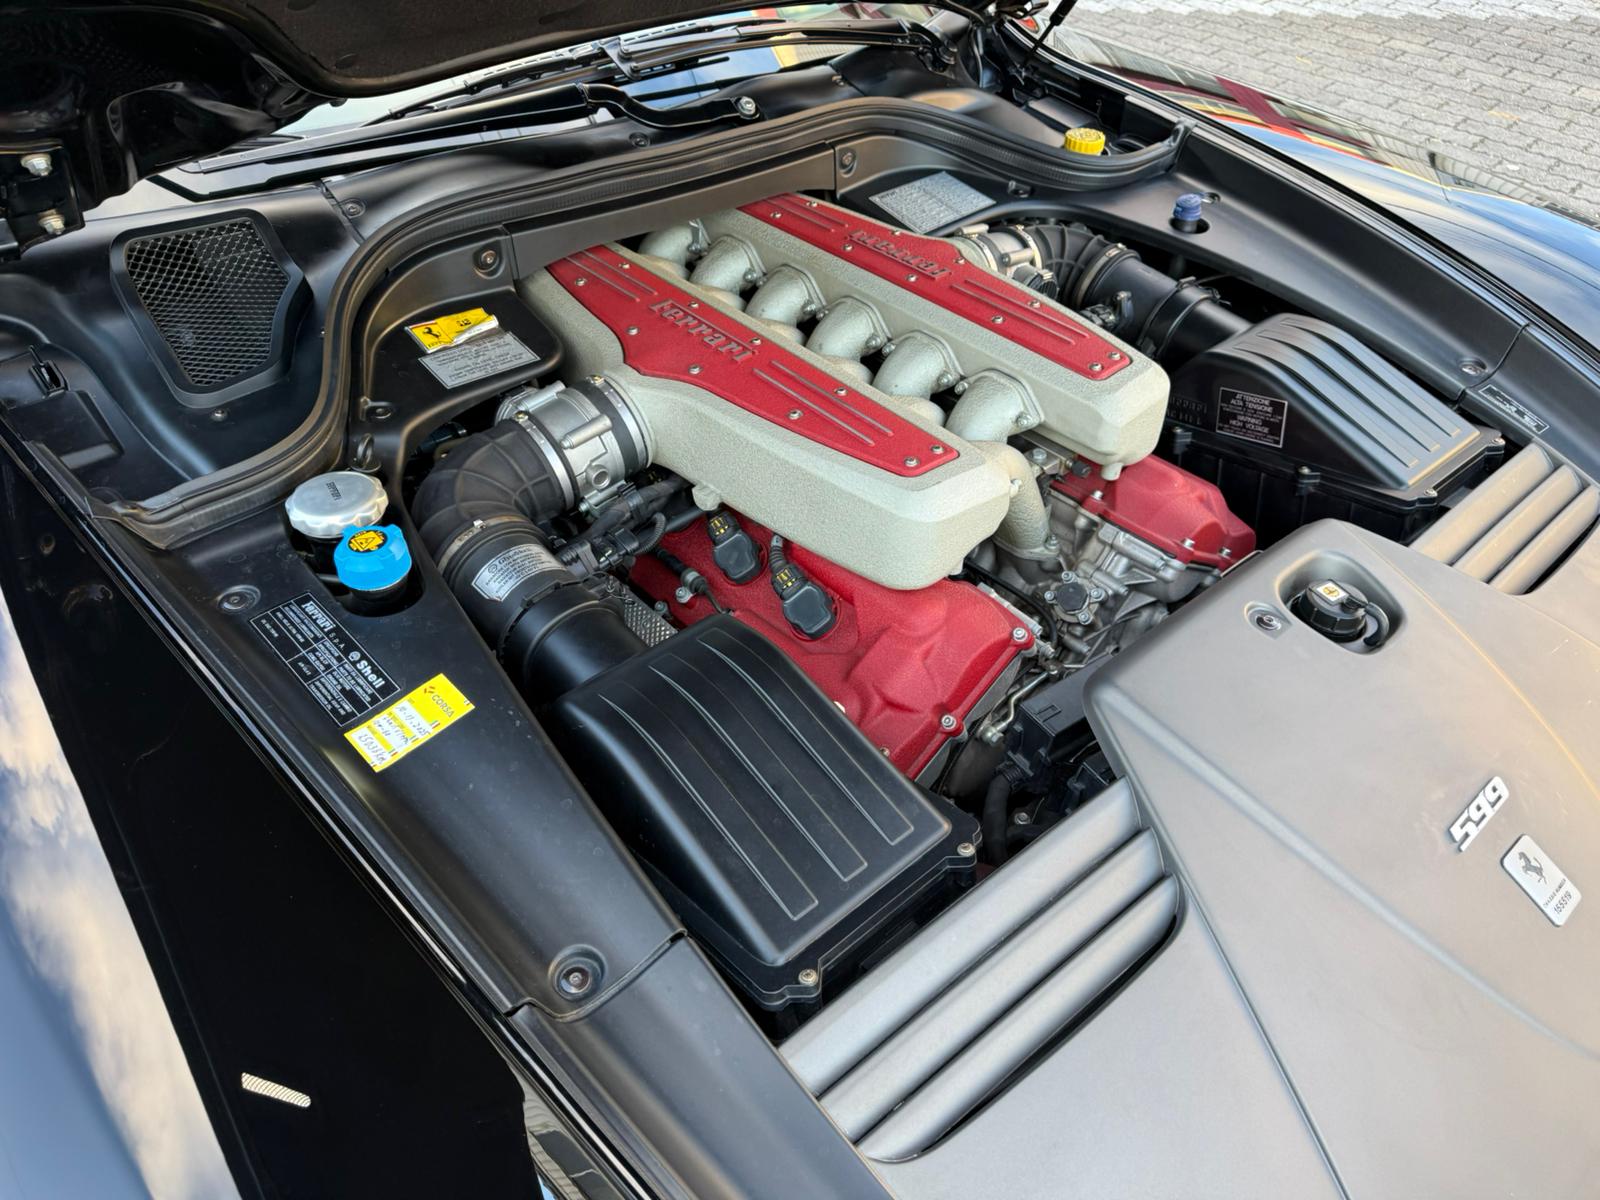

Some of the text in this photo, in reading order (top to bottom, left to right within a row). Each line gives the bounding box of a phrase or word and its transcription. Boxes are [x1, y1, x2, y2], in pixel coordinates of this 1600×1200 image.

[648, 299, 757, 362] Ferrari
[301, 600, 337, 632] Ferrari
[356, 661, 386, 689] Shell
[431, 694, 455, 718] CORSA
[1449, 776, 1510, 852] 599
